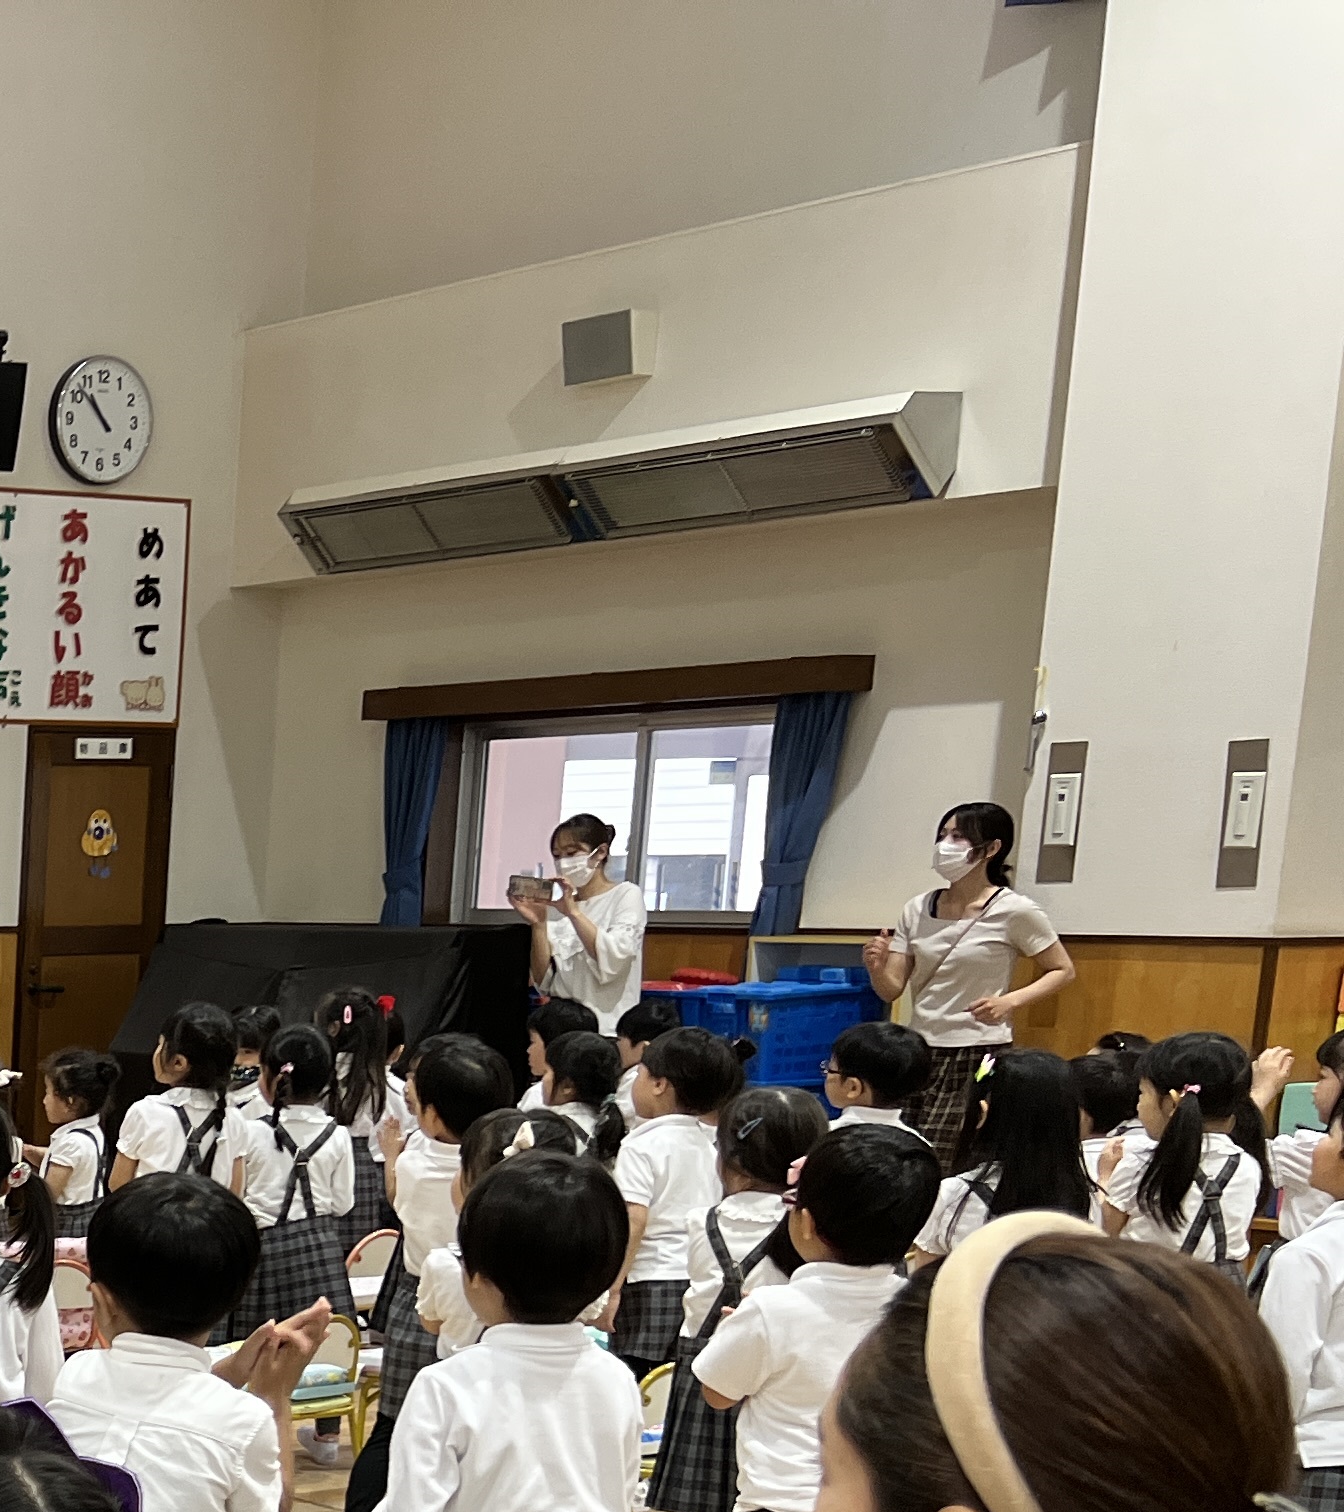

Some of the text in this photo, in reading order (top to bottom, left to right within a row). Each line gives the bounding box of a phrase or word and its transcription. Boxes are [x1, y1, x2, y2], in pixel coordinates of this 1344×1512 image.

[82, 374, 93, 388] 11
[97, 370, 110, 383] 12
[117, 376, 123, 391] 1
[70, 389, 83, 404] 10
[127, 393, 135, 407] 2
[65, 411, 74, 425] 9
[130, 416, 138, 430] 3
[69, 434, 78, 448] 8
[124, 438, 132, 451] 4
[80, 451, 89, 464] 7
[95, 458, 104, 471] 6
[112, 453, 121, 467] 5
[135, 527, 163, 655] めあて
[49, 508, 88, 708] あかるい顔
